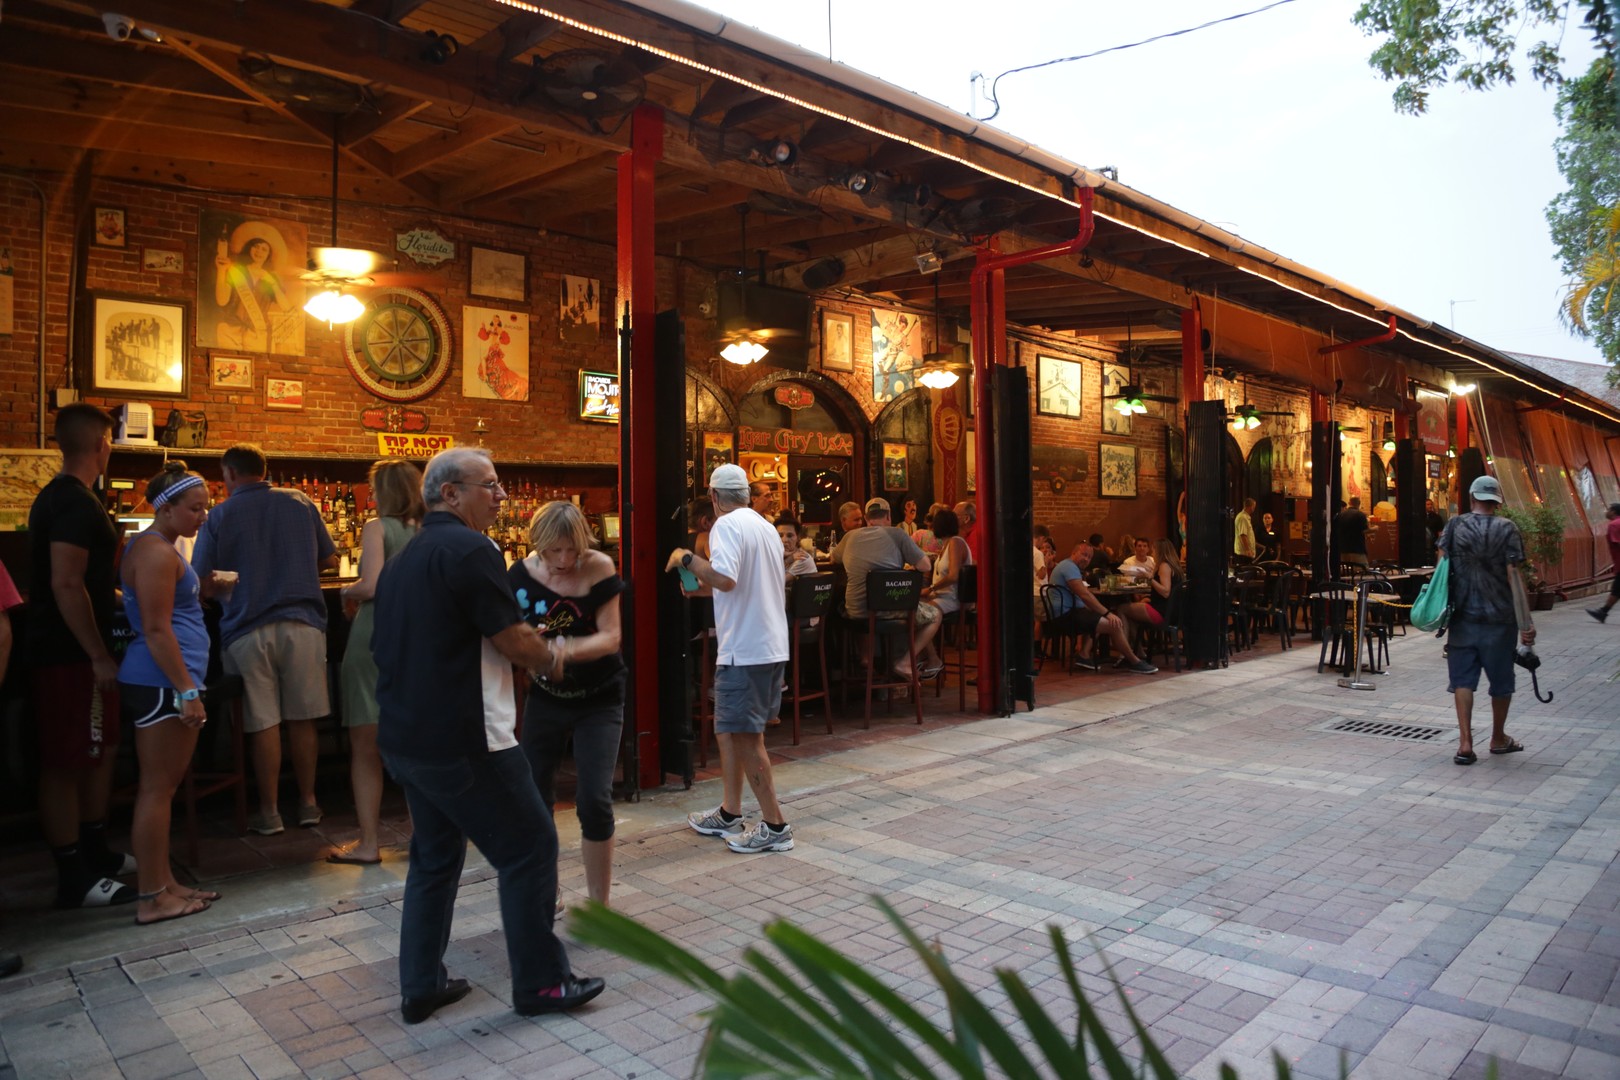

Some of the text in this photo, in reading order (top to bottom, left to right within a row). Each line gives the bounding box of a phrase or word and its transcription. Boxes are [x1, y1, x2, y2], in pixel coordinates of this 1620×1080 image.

[399, 234, 448, 253] Floridita
[384, 435, 449, 449] TIP NOT
